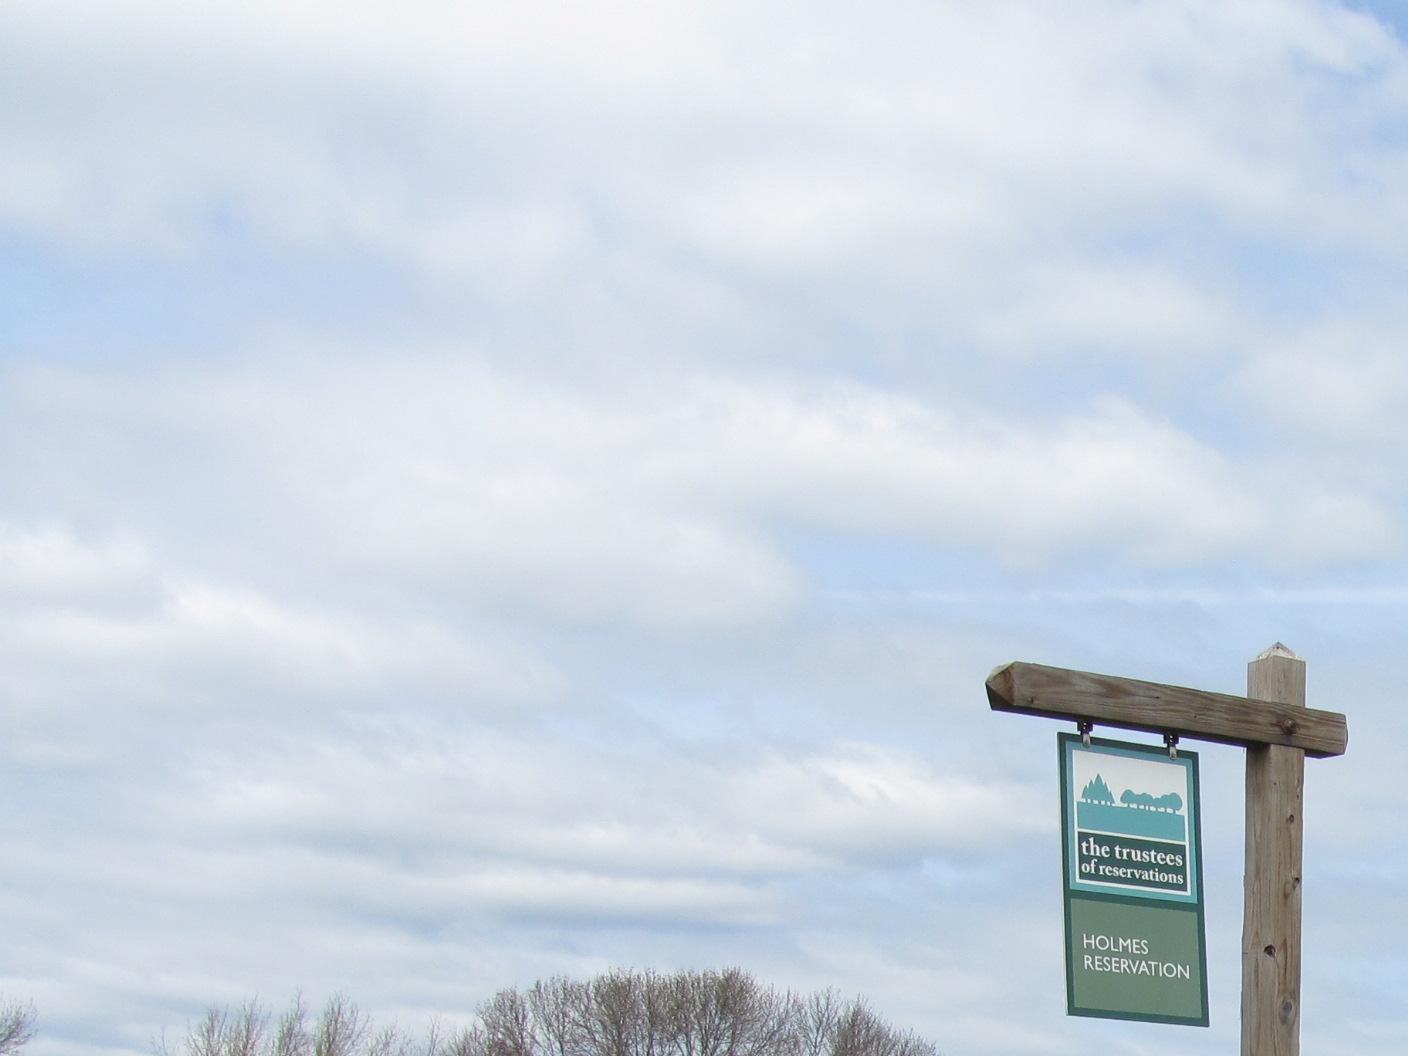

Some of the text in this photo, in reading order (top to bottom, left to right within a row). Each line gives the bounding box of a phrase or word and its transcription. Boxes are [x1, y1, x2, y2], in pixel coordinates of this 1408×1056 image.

[1081, 837, 1183, 867] the trustees
[1081, 859, 1184, 885] of reservations
[1083, 933, 1149, 955] HOLMES
[1084, 954, 1190, 979] RESERVATION
